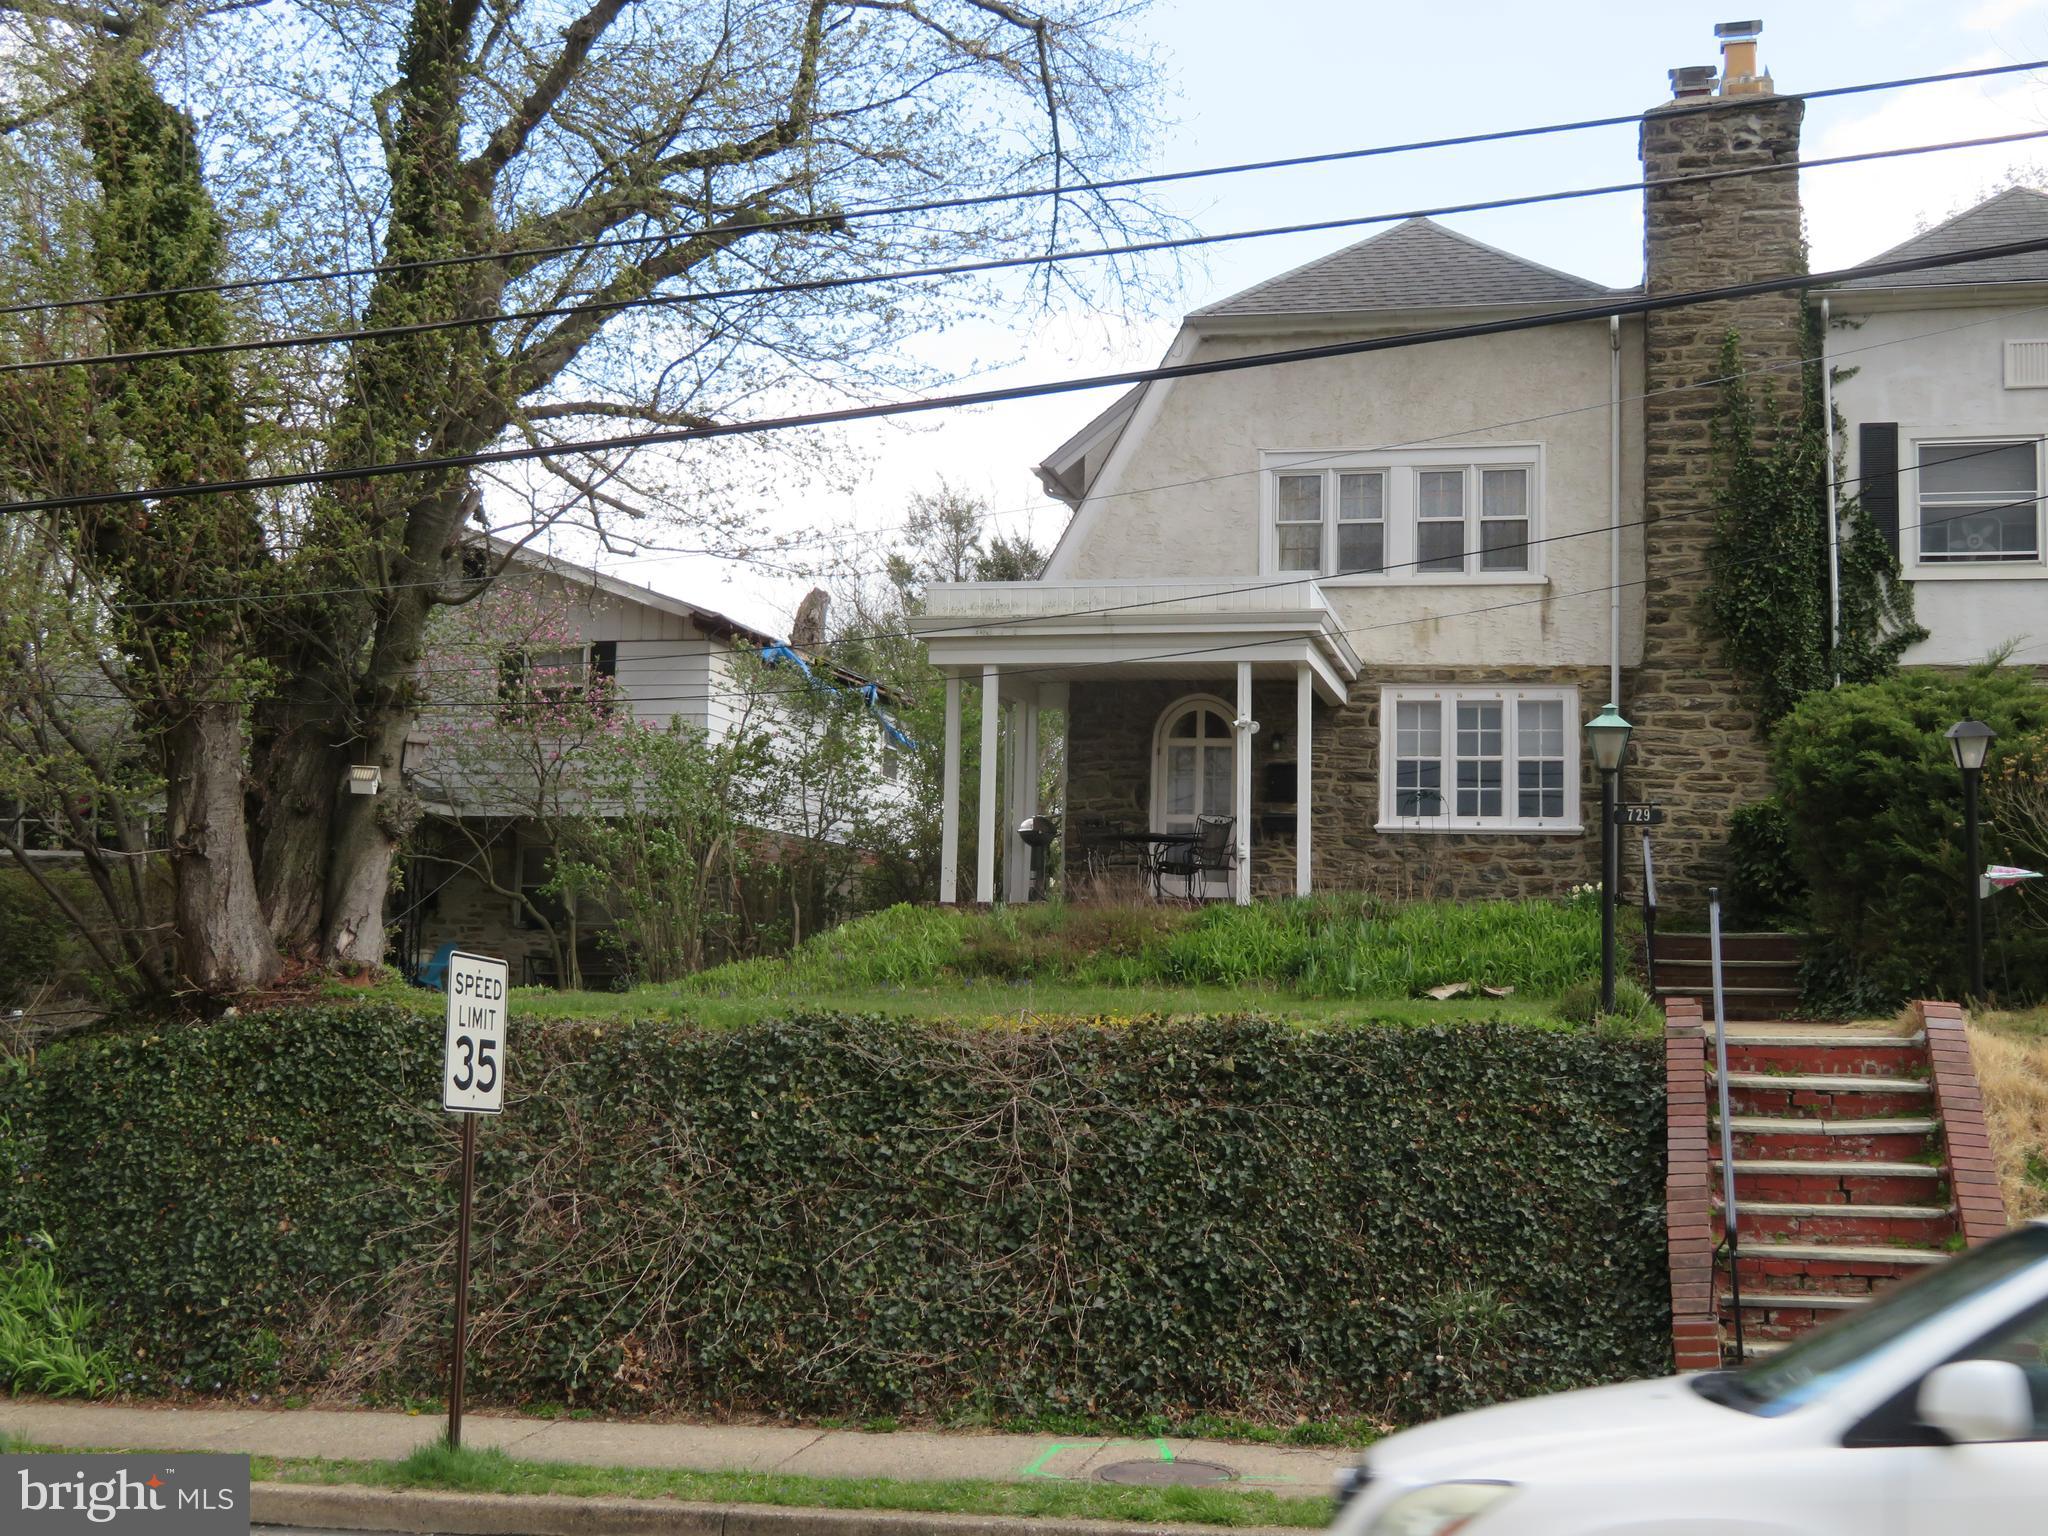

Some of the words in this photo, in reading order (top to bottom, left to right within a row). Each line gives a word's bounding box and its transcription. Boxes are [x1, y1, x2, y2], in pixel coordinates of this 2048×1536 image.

[1627, 808, 1650, 822] 729
[455, 972, 502, 1000] SPEED
[459, 1005, 496, 1031] LIMIT
[453, 1035, 497, 1093] 35
